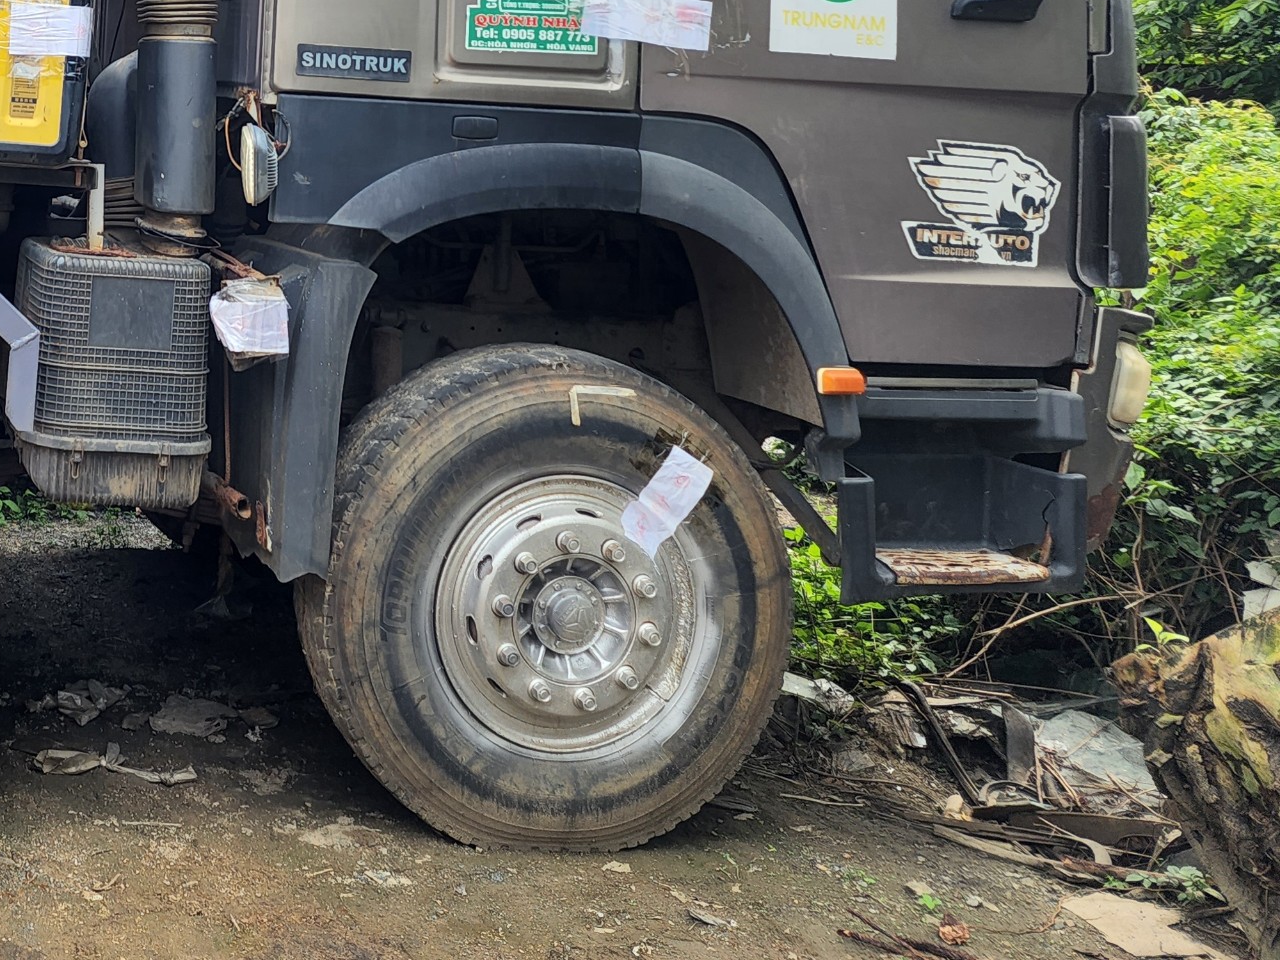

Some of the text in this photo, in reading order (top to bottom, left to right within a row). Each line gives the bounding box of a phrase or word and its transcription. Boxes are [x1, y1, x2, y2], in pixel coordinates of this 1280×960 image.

[475, 12, 582, 32] QUỲNH NHẬ
[783, 9, 887, 32] TRUNGNAM
[475, 27, 499, 39] Tel:
[502, 29, 535, 40] 0905
[539, 30, 563, 41] 887
[301, 51, 407, 74] SINOTRUK
